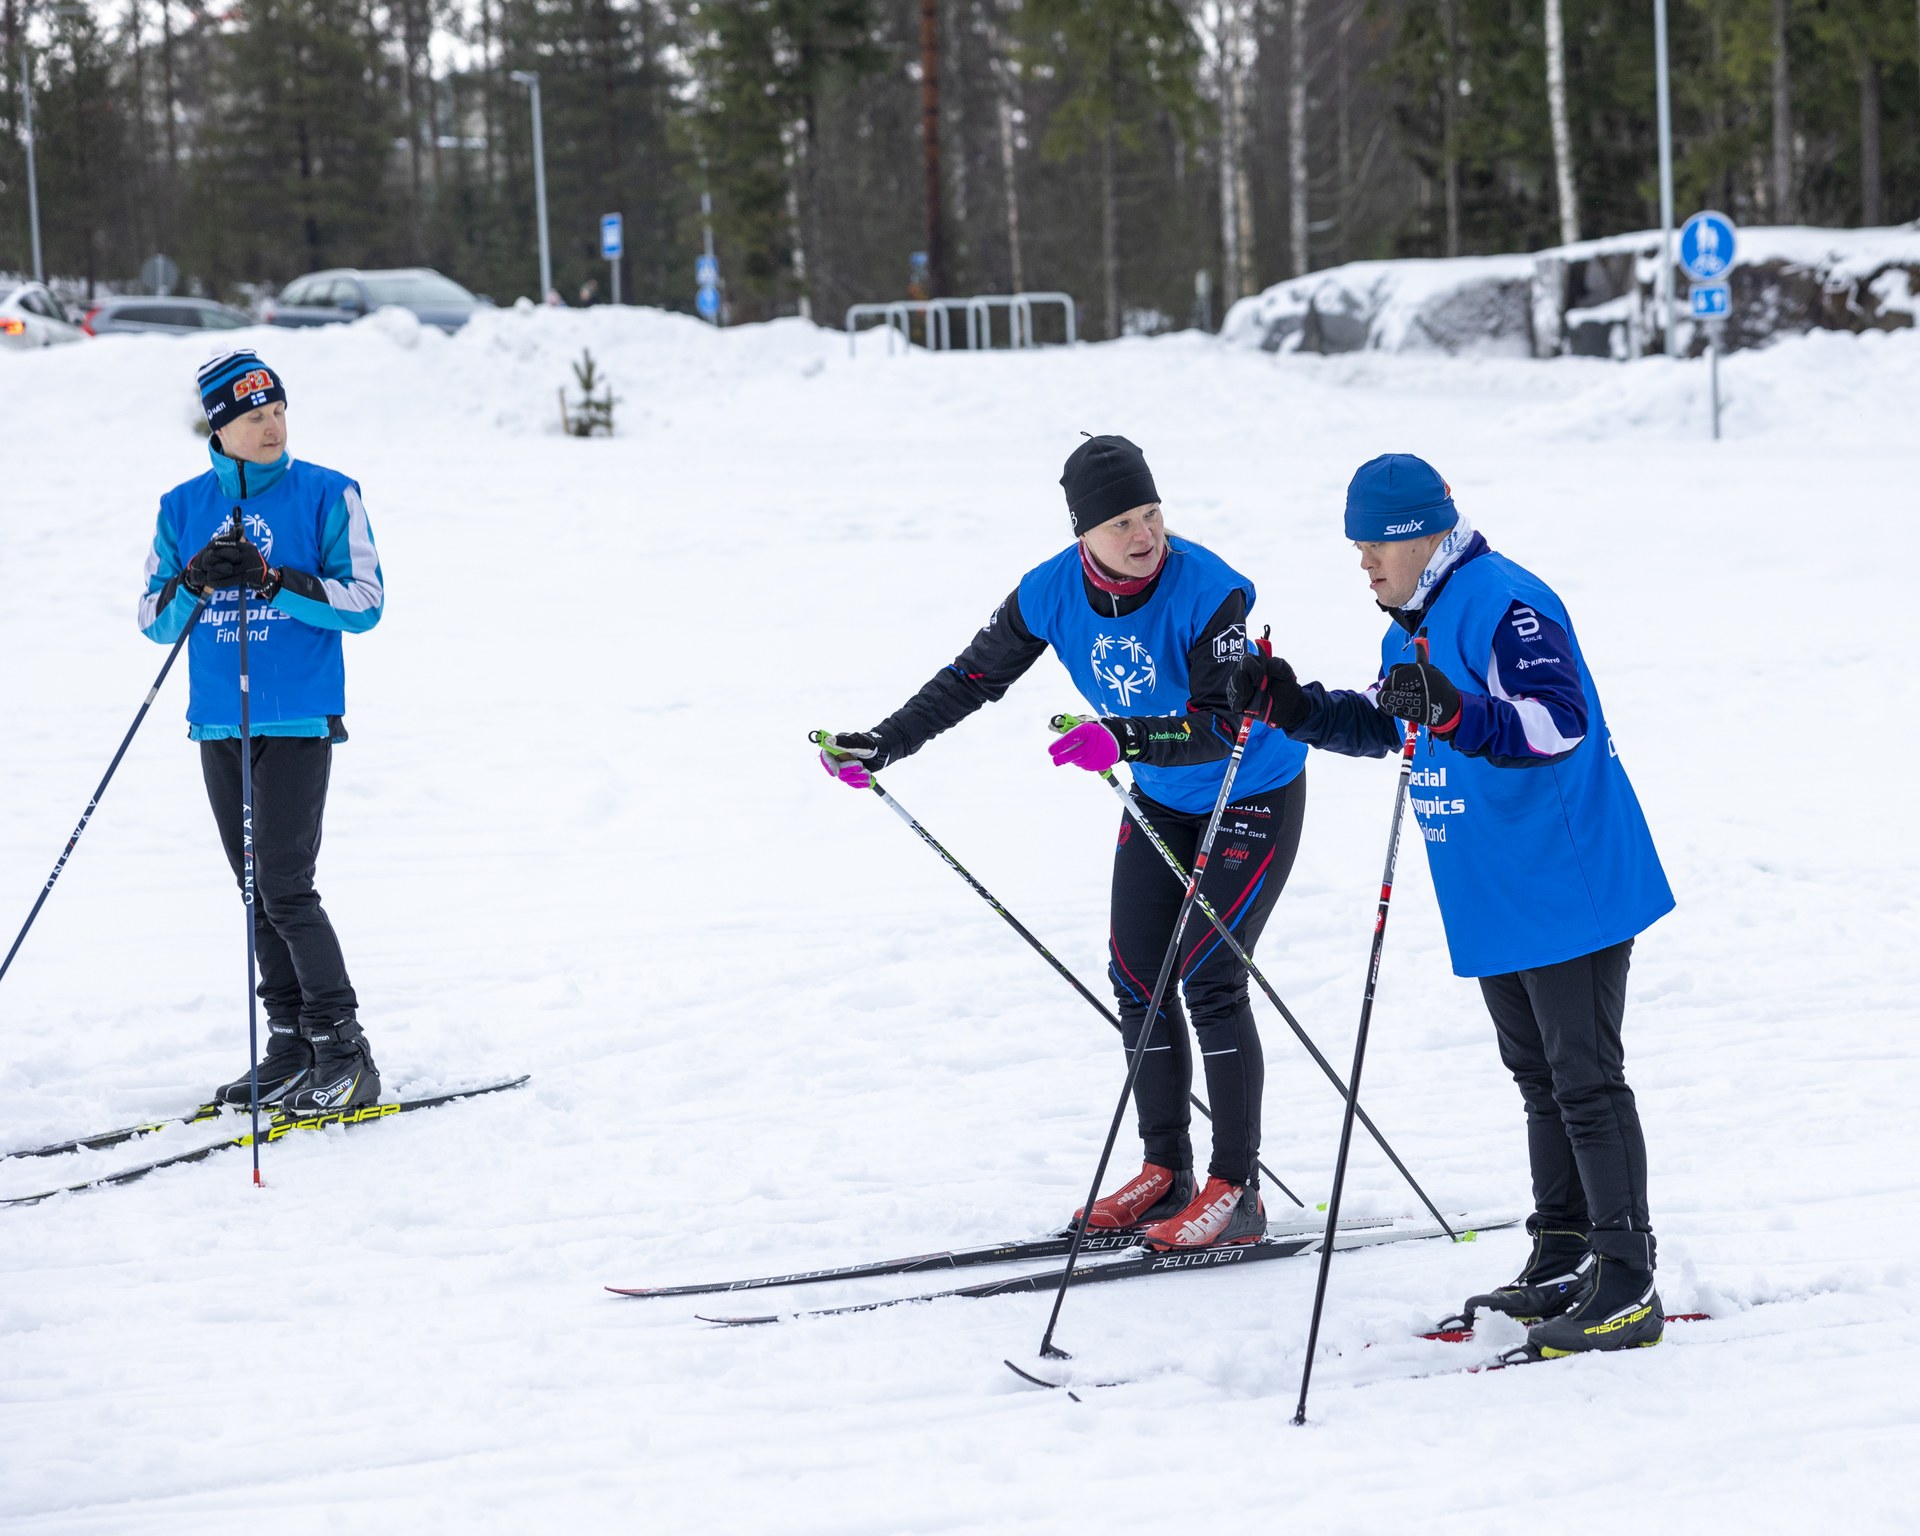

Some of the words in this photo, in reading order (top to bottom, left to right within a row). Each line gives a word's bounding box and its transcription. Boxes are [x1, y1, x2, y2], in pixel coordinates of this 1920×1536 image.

[1234, 828, 1246, 836] the
[1248, 830, 1267, 839] Clerk
[1222, 847, 1250, 861] JYKI
[1116, 1173, 1163, 1206] alpina
[1151, 1249, 1244, 1270] PELTONEN
